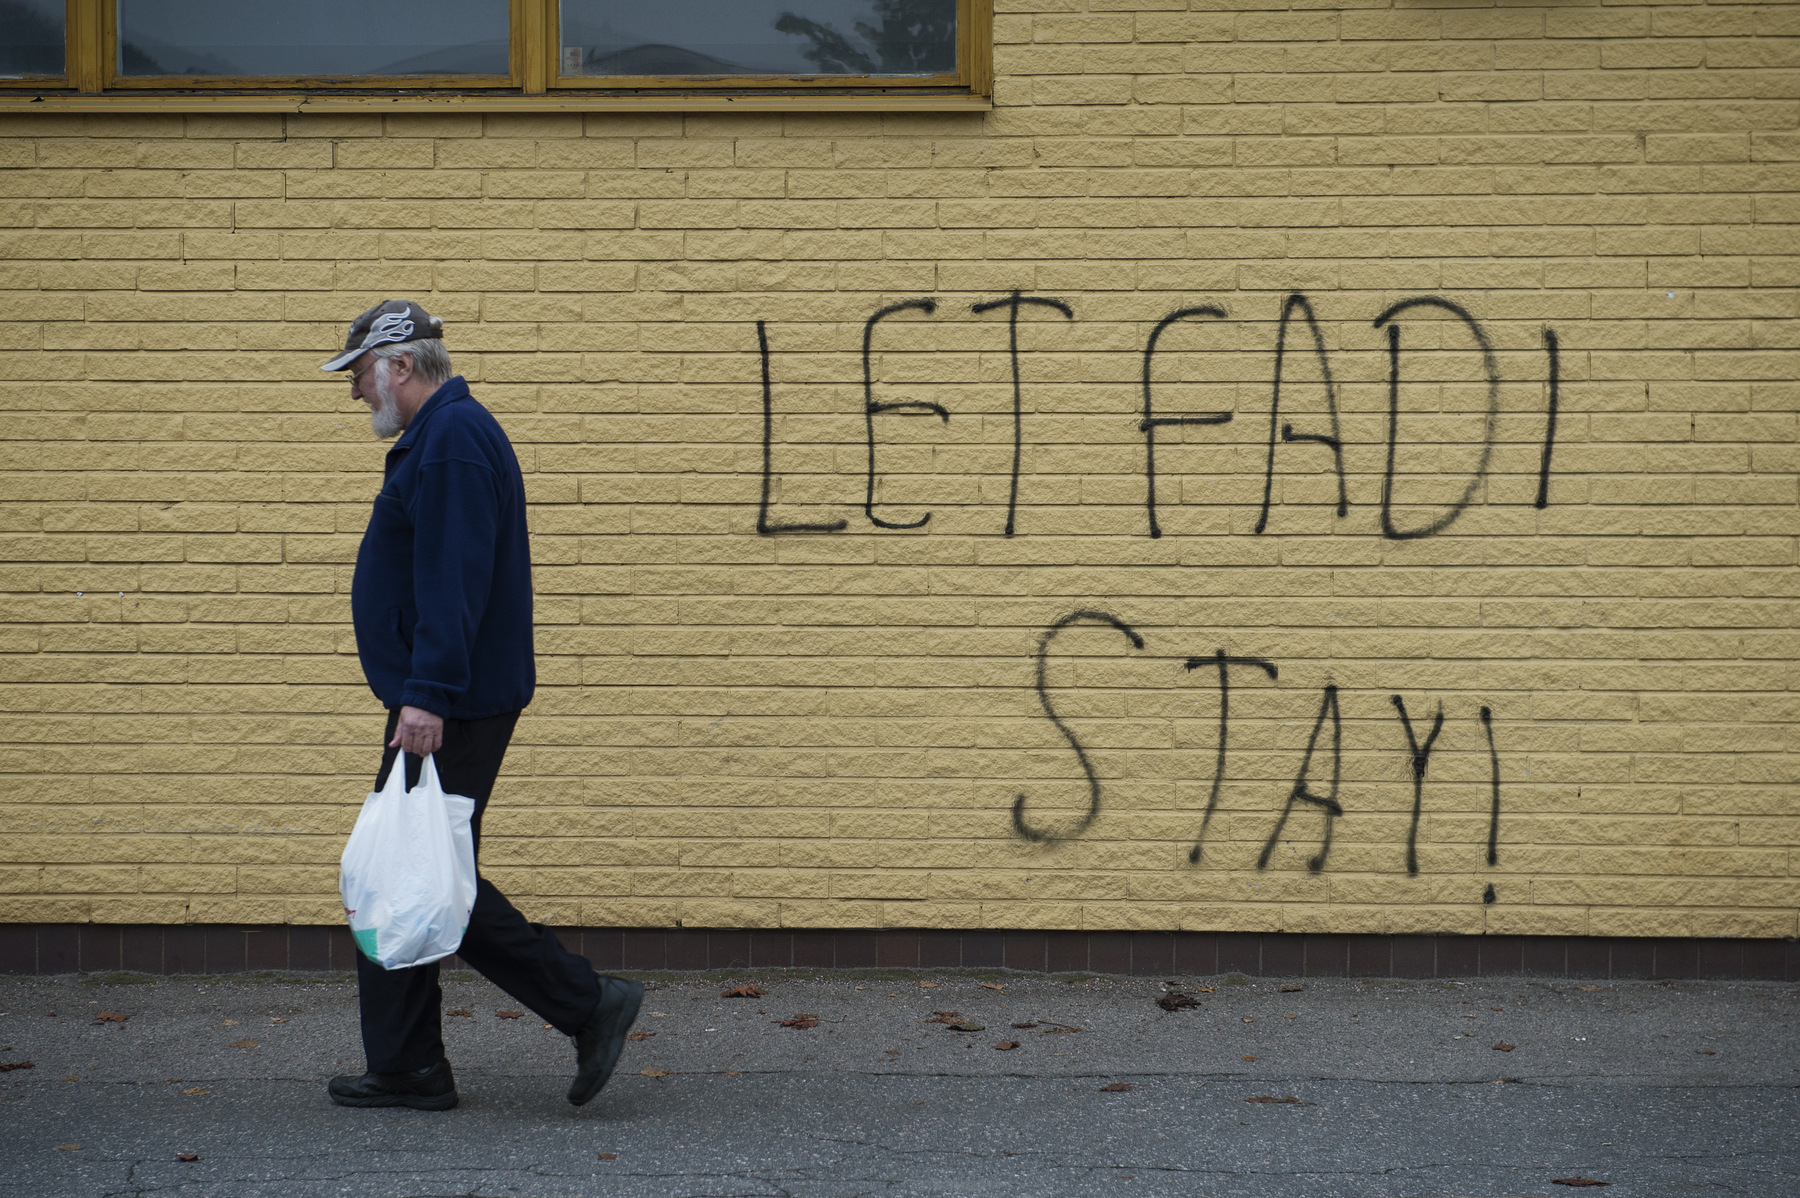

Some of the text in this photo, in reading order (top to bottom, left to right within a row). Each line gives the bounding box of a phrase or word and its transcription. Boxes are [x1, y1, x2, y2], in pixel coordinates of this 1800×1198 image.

[757, 289, 1560, 540] LET FADI
[1012, 609, 1500, 904] STAY!
